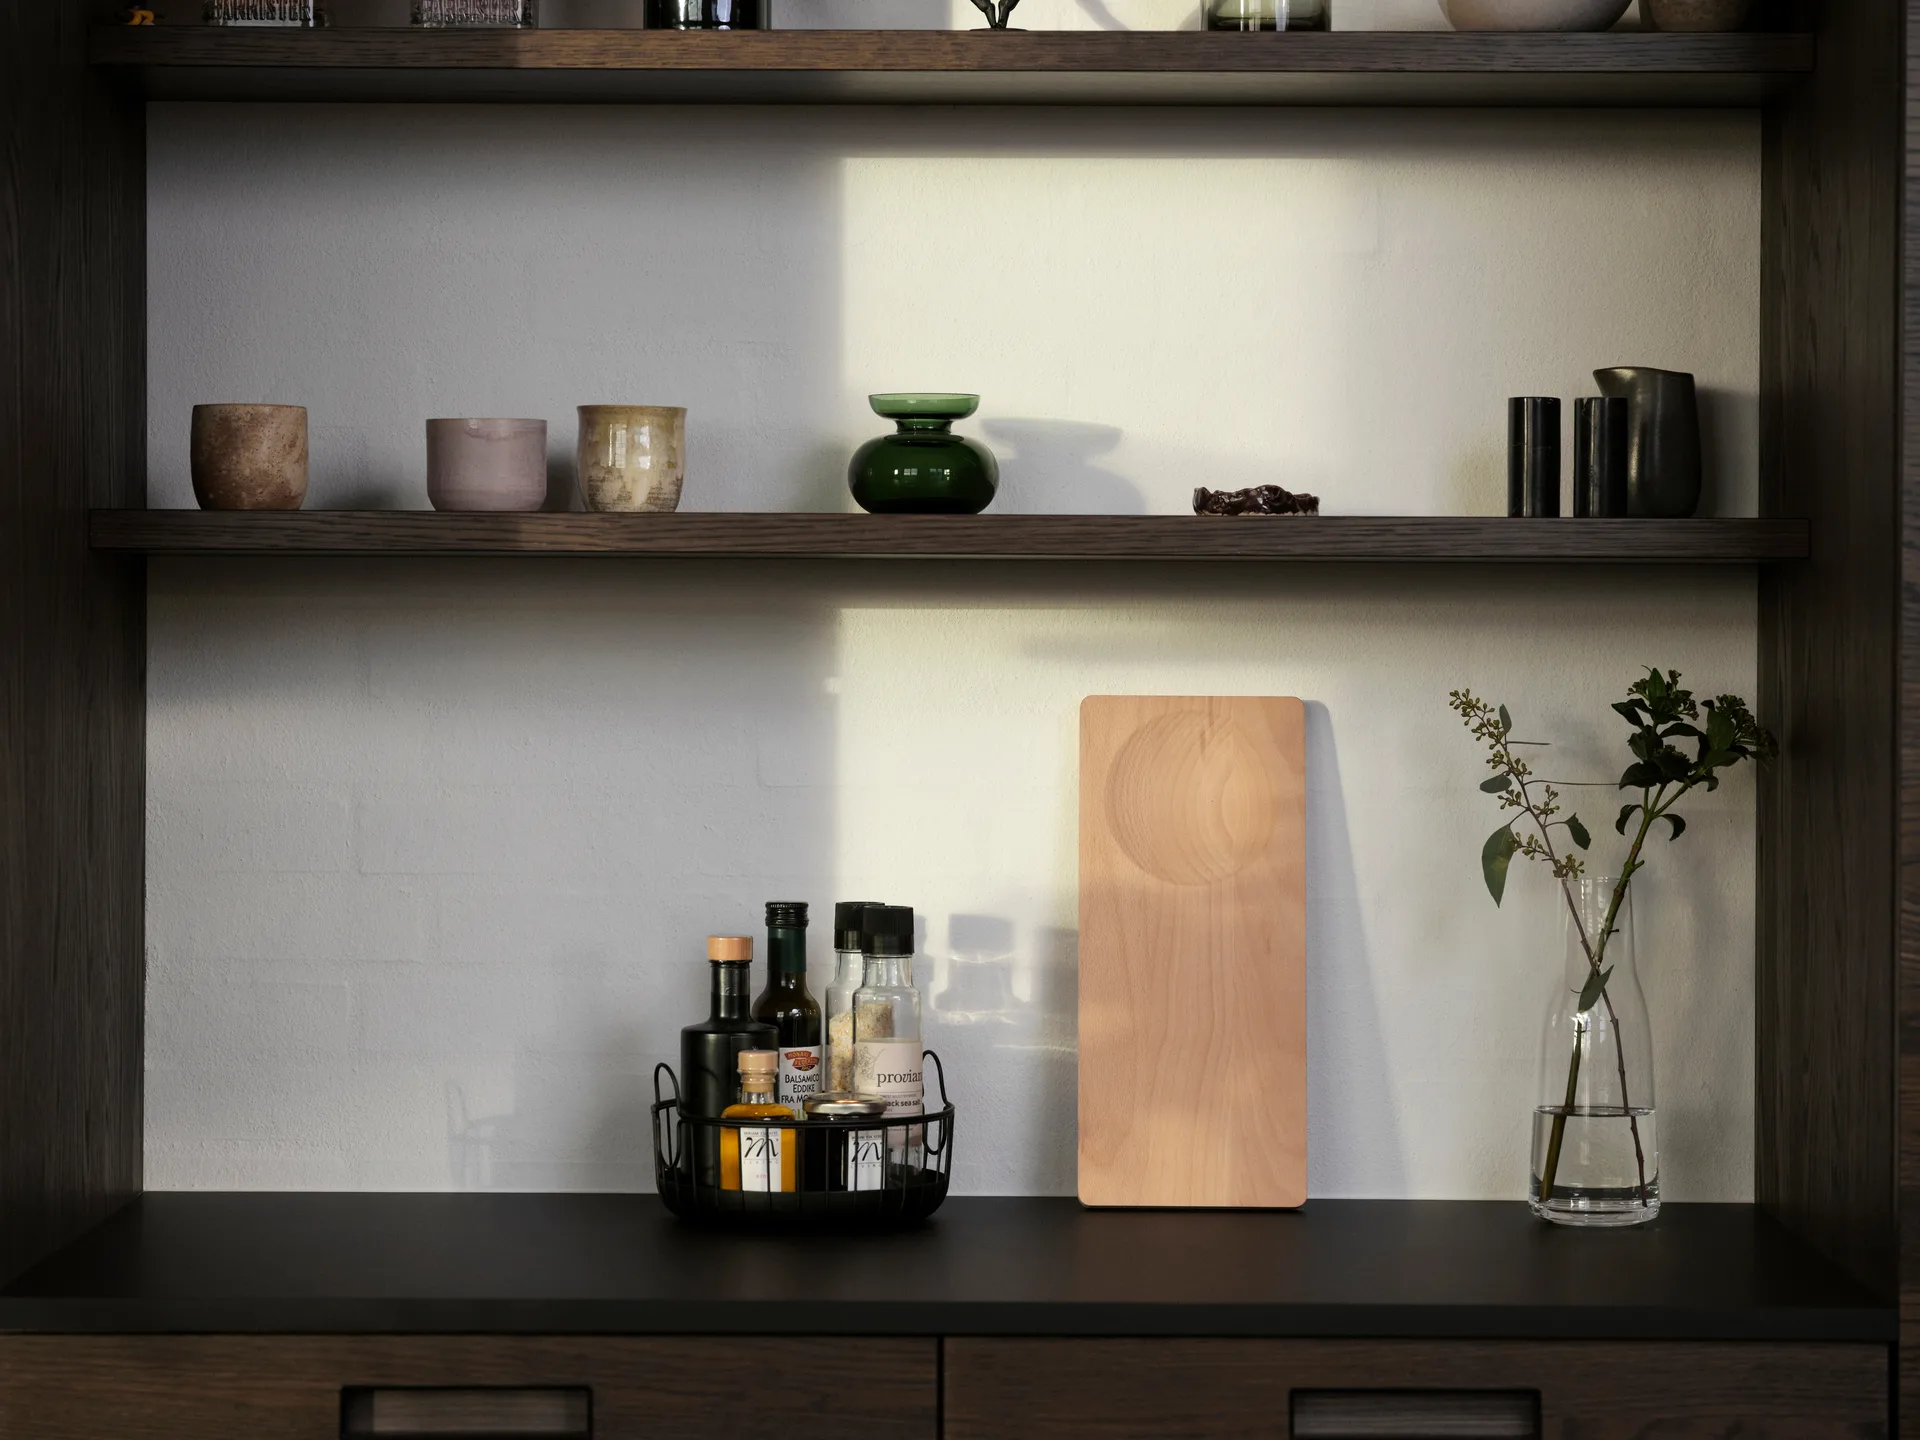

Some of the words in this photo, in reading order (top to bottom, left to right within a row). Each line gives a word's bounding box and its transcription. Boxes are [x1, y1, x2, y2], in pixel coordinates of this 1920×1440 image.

[785, 1073, 820, 1083] BALSAMICO
[792, 1084, 815, 1093] EDDIKE
[781, 1095, 794, 1104] FRA
